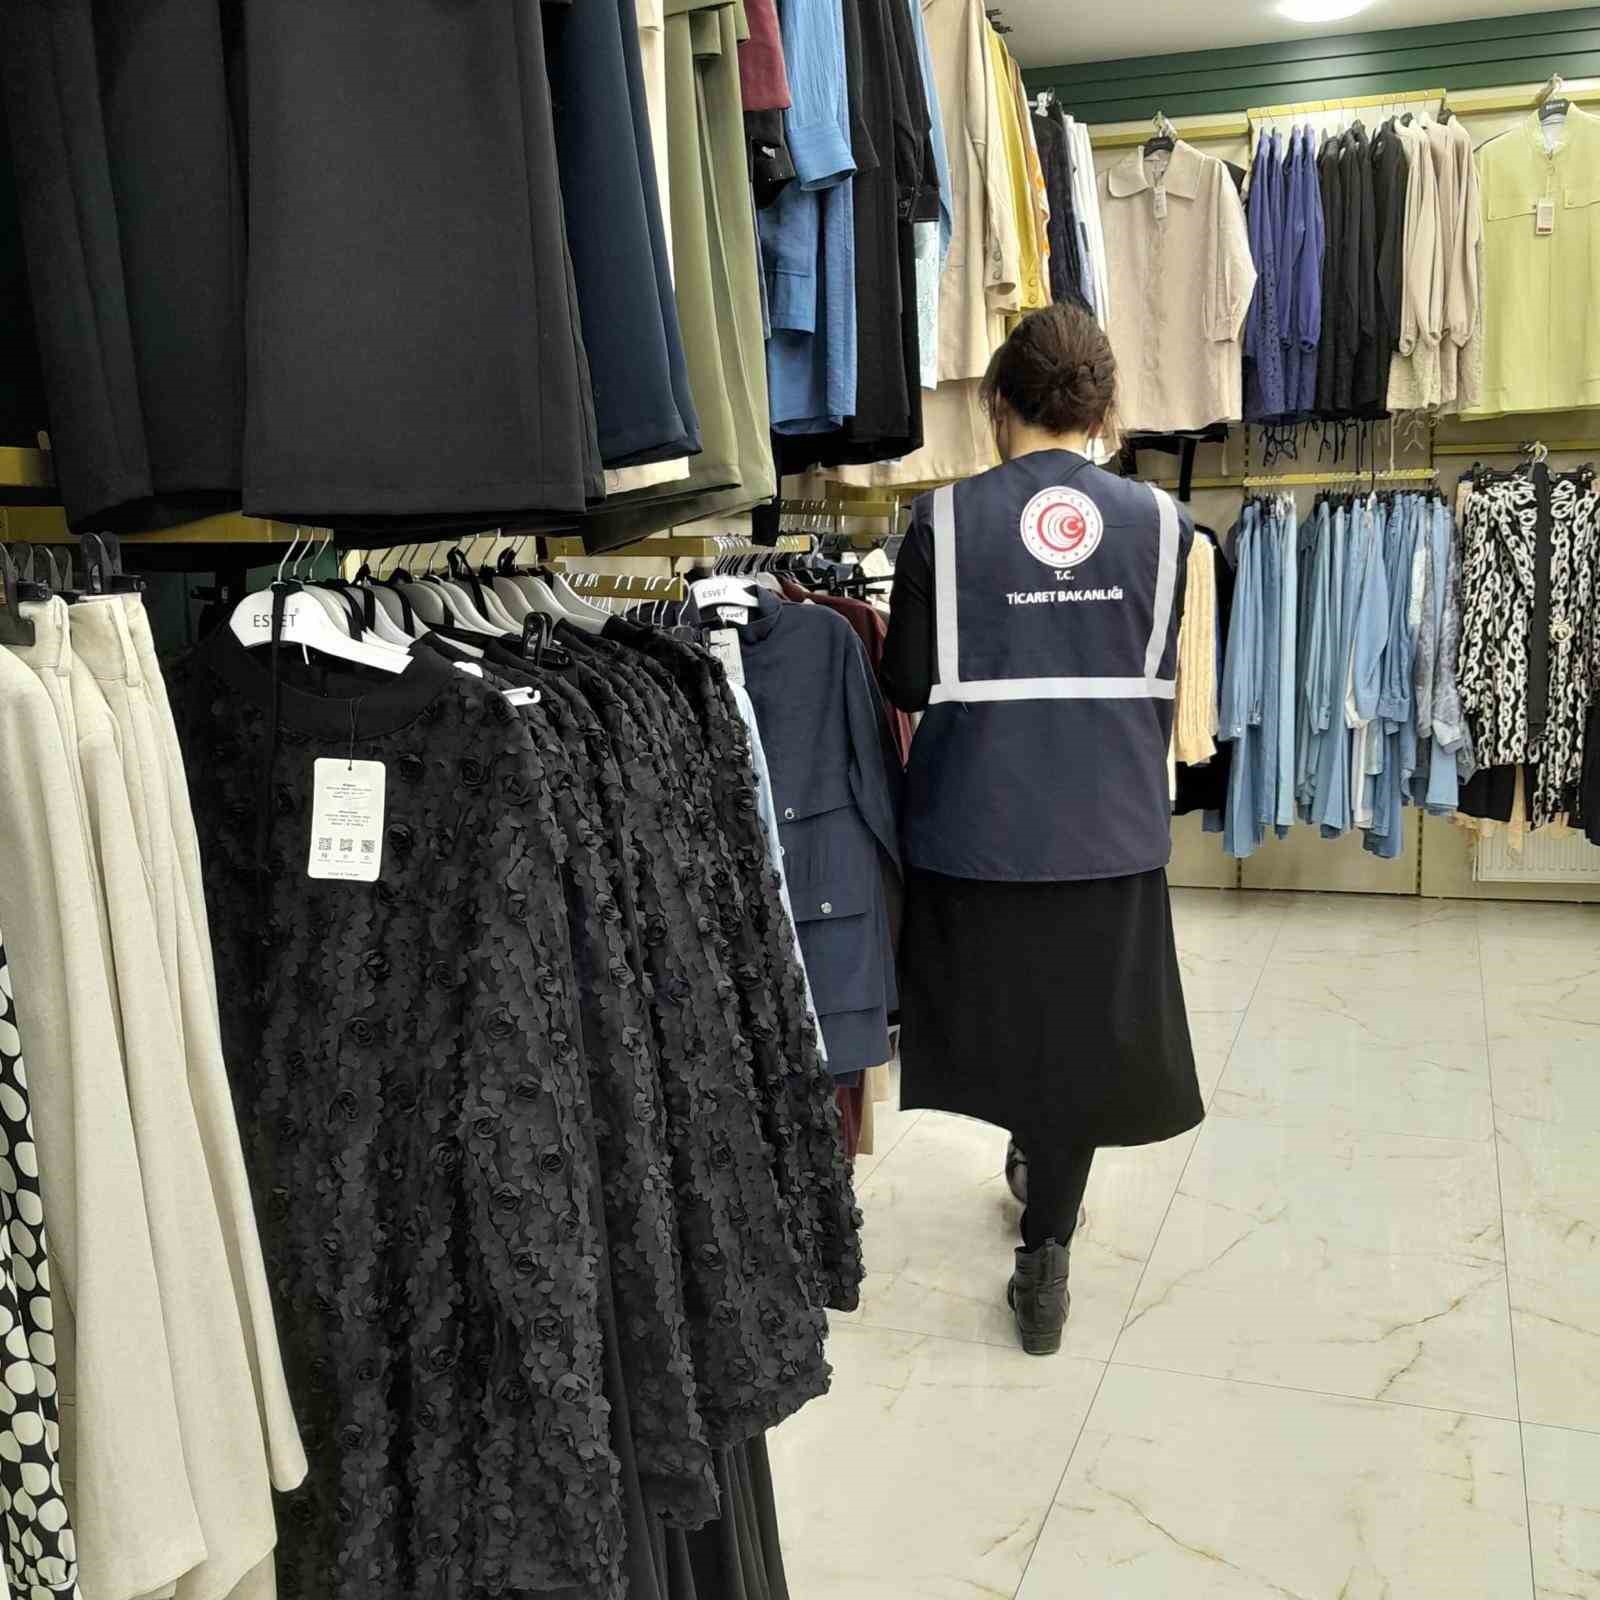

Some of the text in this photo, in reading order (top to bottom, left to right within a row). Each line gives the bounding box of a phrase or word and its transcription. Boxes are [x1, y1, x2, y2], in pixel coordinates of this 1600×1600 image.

[1054, 570, 1075, 581] T.C.
[1006, 586, 1123, 605] TİCARET BAKANLIĞI
[253, 614, 297, 628] ESET
